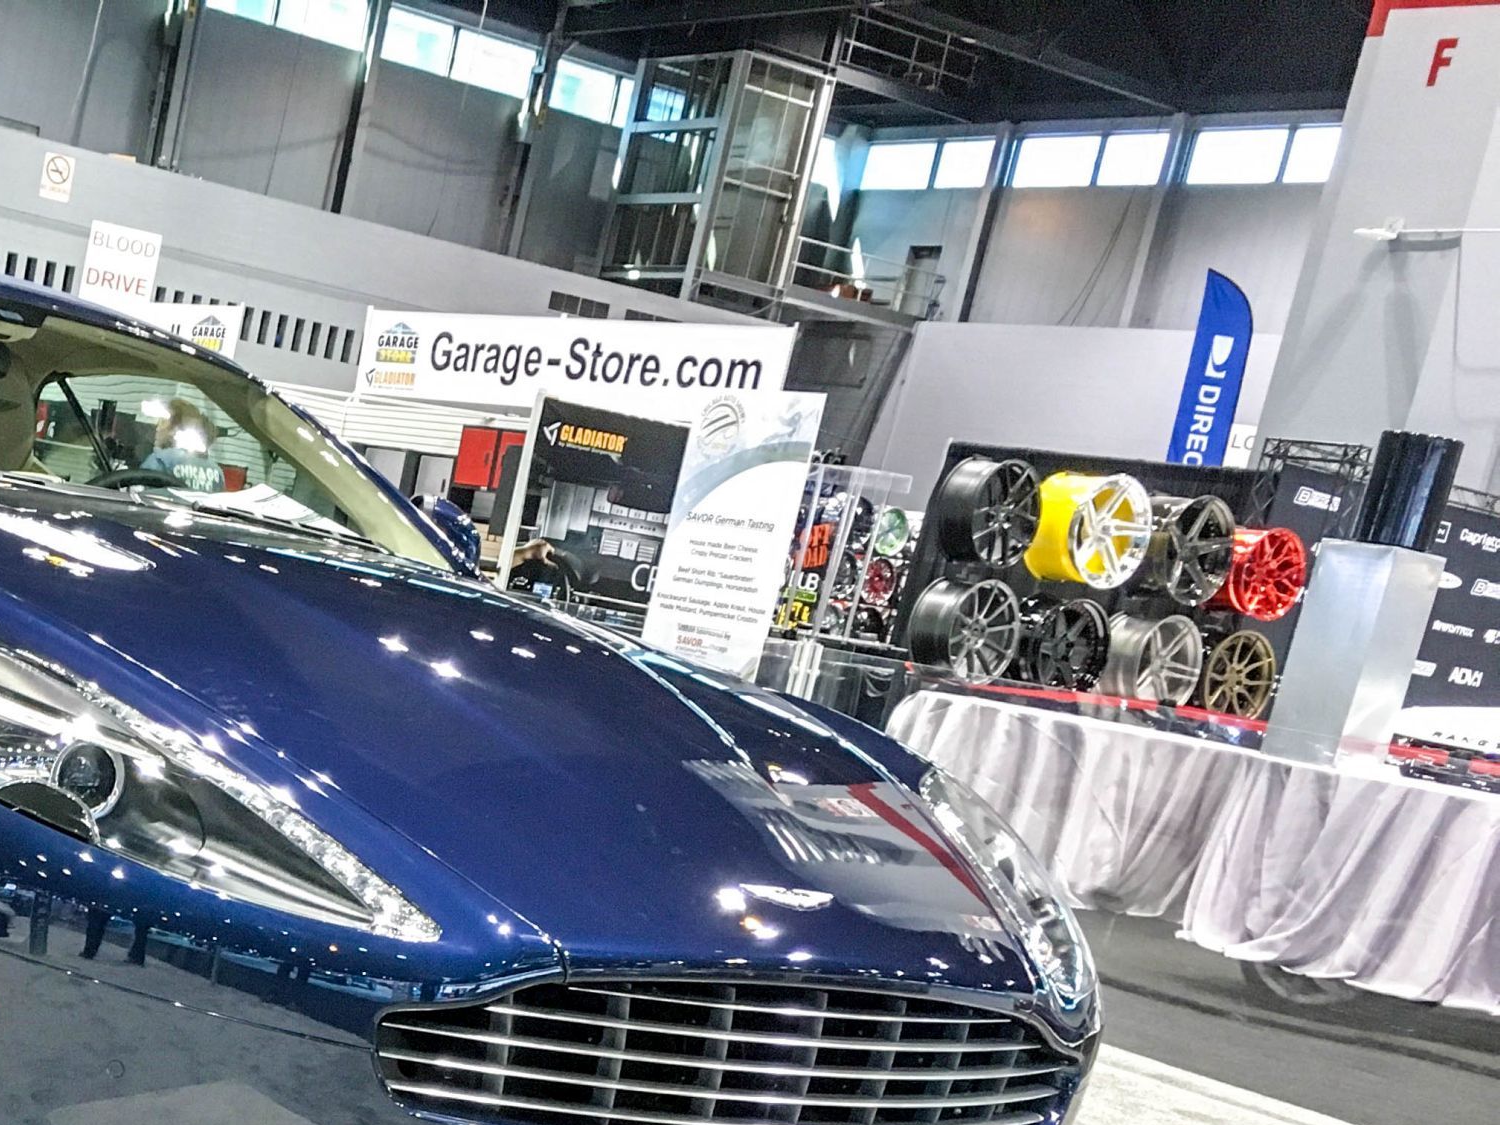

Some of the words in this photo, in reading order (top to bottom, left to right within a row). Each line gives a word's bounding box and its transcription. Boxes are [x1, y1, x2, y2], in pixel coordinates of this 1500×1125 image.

[1426, 37, 1459, 87] F
[92, 230, 156, 258] BLOOD
[86, 267, 148, 297] DRIVE
[192, 326, 226, 338] GARAGE
[378, 335, 420, 349] GARAGE
[430, 331, 763, 390] Garage-Store.com
[374, 371, 416, 386] GLADIATOR
[560, 424, 625, 452] GLADIATOR
[686, 511, 714, 523] SAVOR
[715, 515, 745, 527] German
[747, 519, 775, 532] Tasting
[676, 635, 703, 647] SAVOR
